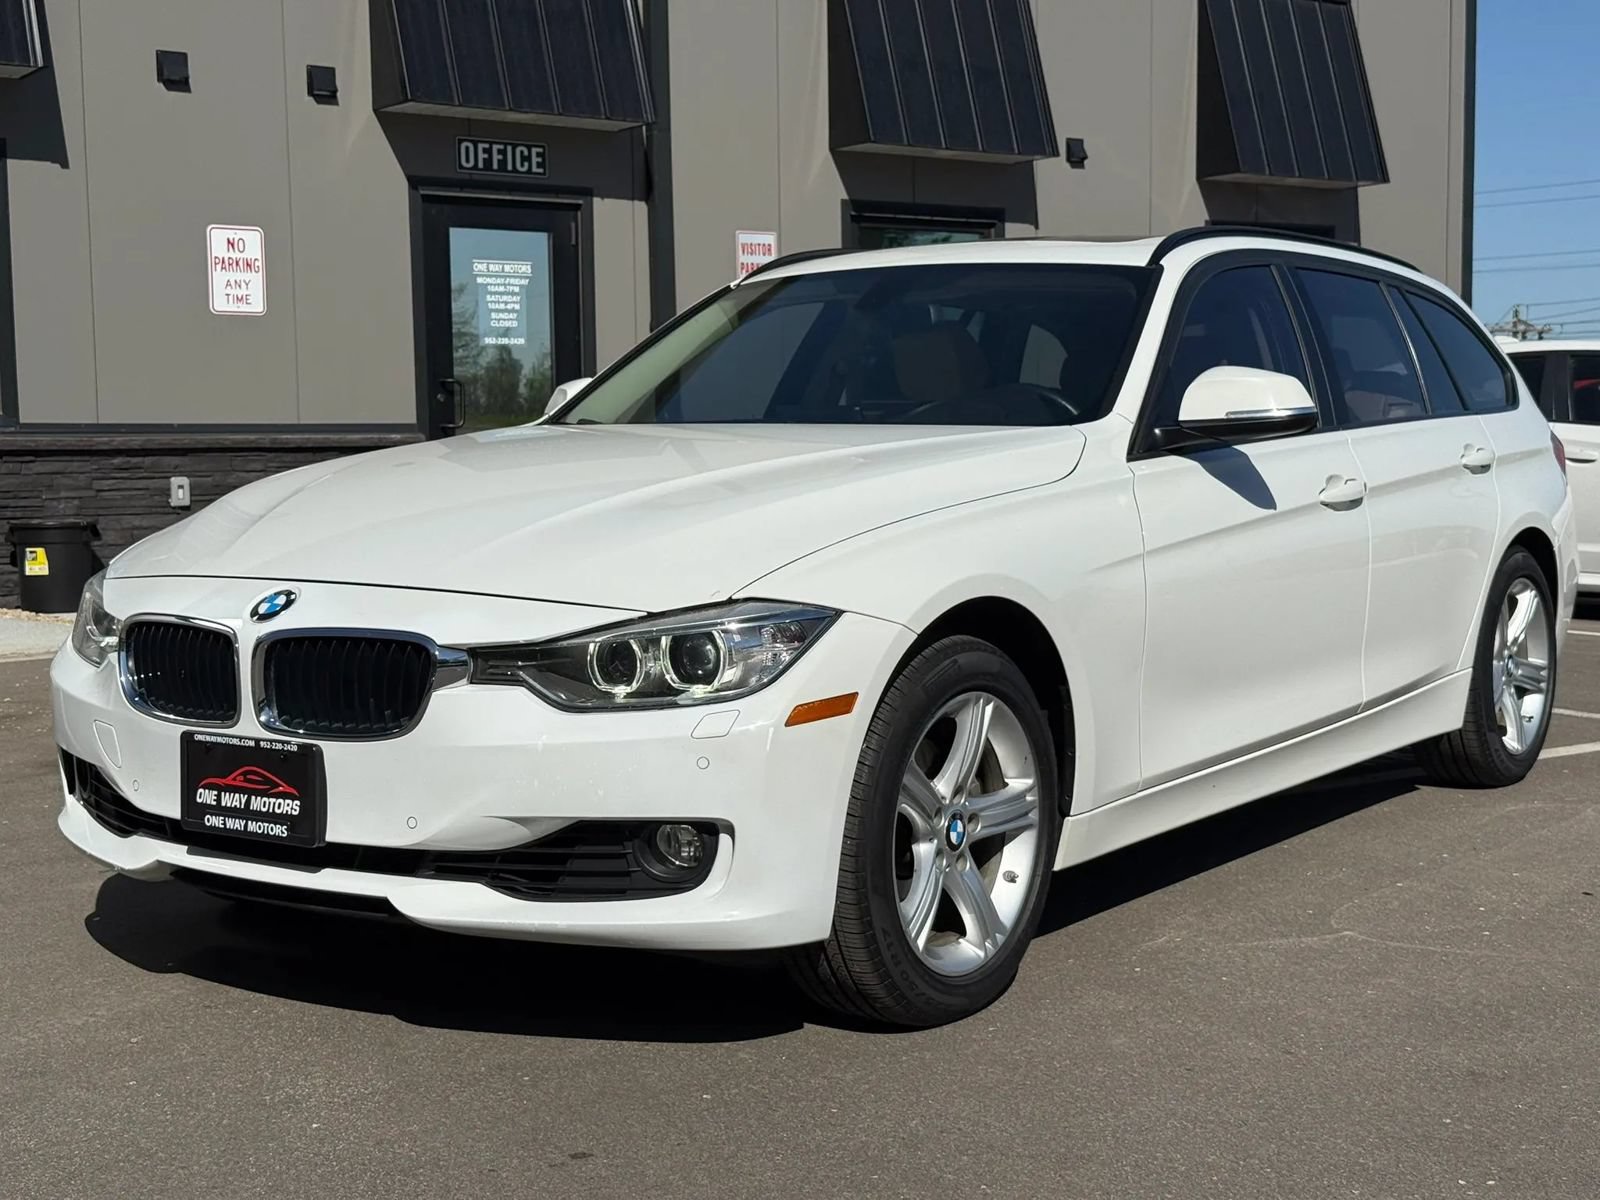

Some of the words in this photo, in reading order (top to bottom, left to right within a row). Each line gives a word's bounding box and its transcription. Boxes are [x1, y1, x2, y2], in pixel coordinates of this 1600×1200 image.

[460, 141, 545, 174] OFFICE
[226, 237, 246, 253] NO
[741, 242, 773, 256] VISITOR
[213, 255, 261, 273] PARKING
[473, 262, 488, 272] ONE
[488, 263, 503, 272] WAY
[503, 264, 532, 274] MOTORS
[224, 279, 252, 290] ANY
[476, 276, 530, 285] MONDAY-FRIDAY
[225, 293, 252, 305] TIME
[486, 294, 521, 302] SATURDAY
[490, 311, 518, 319] SUNDAY
[490, 319, 518, 327] CLOSED
[193, 733, 256, 747] ONEWAYMOTORS.COM
[259, 741, 298, 752] 952-220-2420
[196, 788, 218, 805] ONE
[220, 791, 248, 809] WAY
[249, 795, 300, 816] MOTORS
[204, 814, 225, 828] ONE
[225, 817, 246, 831] WAY
[247, 820, 288, 837] MOTORS
